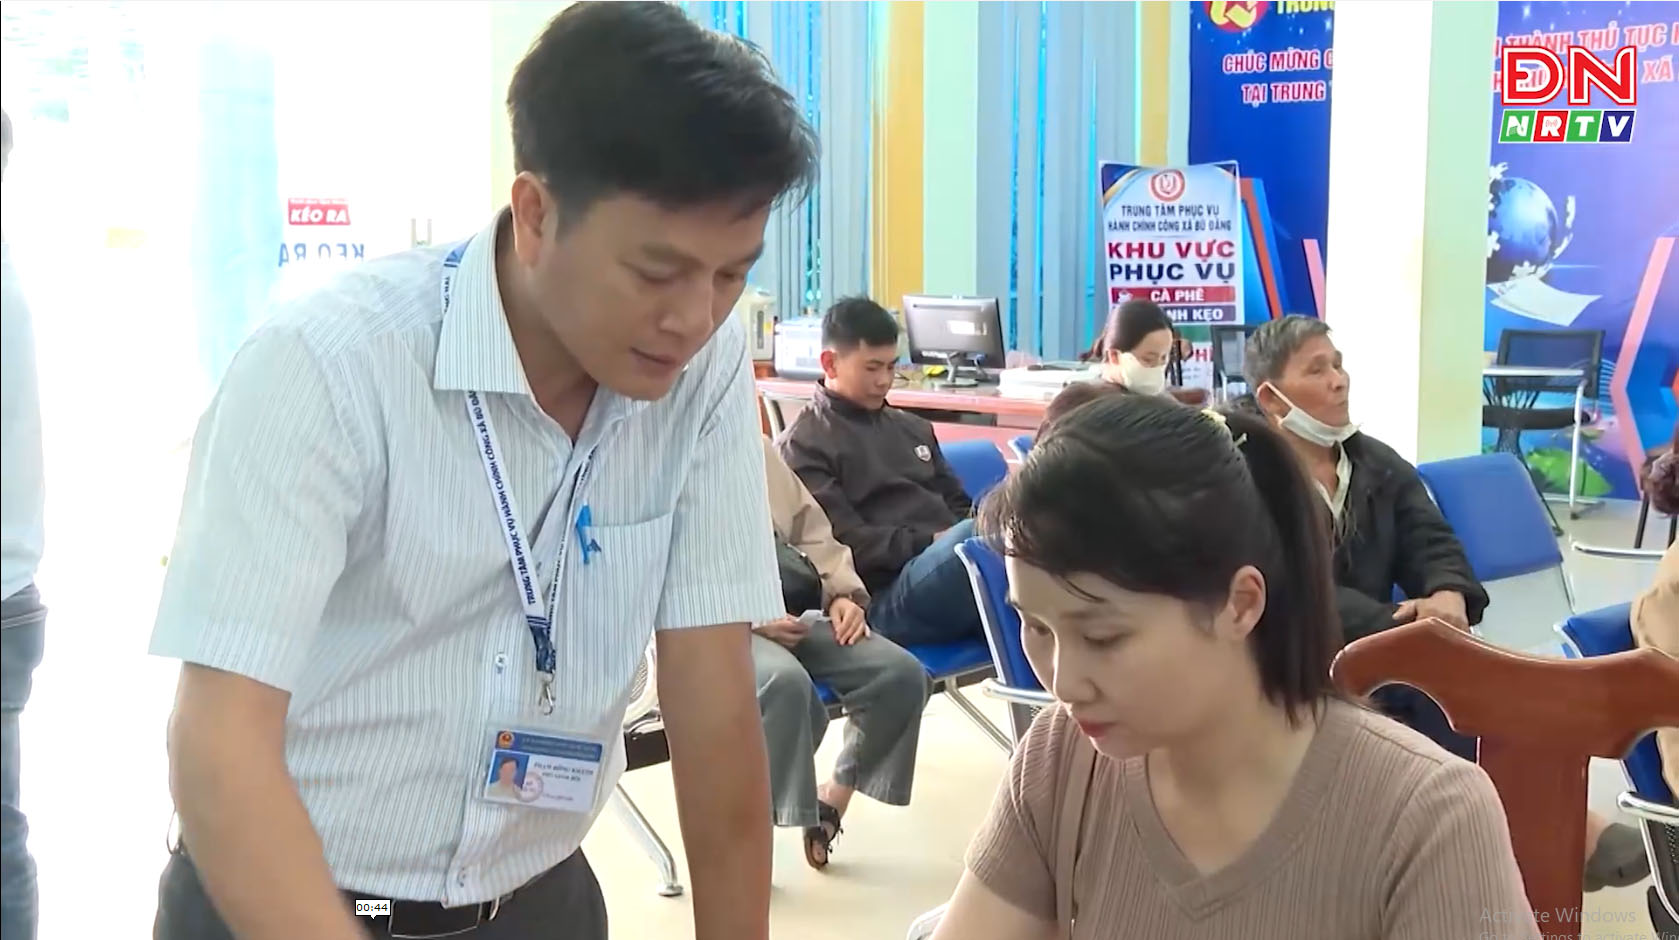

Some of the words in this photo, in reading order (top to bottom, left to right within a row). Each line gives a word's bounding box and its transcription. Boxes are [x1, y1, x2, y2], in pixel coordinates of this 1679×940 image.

[1624, 23, 1667, 52] TỤC
[1223, 49, 1267, 74] CHÚC
[1269, 47, 1320, 72] MỪNG
[1242, 83, 1268, 107] TẠI
[1271, 80, 1326, 102] TRUNG
[290, 206, 323, 222] KÉO
[326, 209, 347, 222] RA
[1122, 205, 1151, 216] TRUNG
[1155, 203, 1175, 216] TÂM
[1179, 205, 1204, 219] PHỤC
[1158, 219, 1180, 231] CÔNG
[1108, 242, 1165, 258] KHU
[1176, 240, 1235, 262] VỰC
[1110, 263, 1184, 285] PHỤC
[1195, 263, 1235, 284] VỤ
[1151, 288, 1171, 302] CÀ
[1174, 287, 1205, 302] PHÊ
[1166, 309, 1188, 320] NH
[1192, 308, 1223, 321] KẸO
[482, 434, 495, 460] CÔNG
[521, 575, 536, 605] TRUNG
